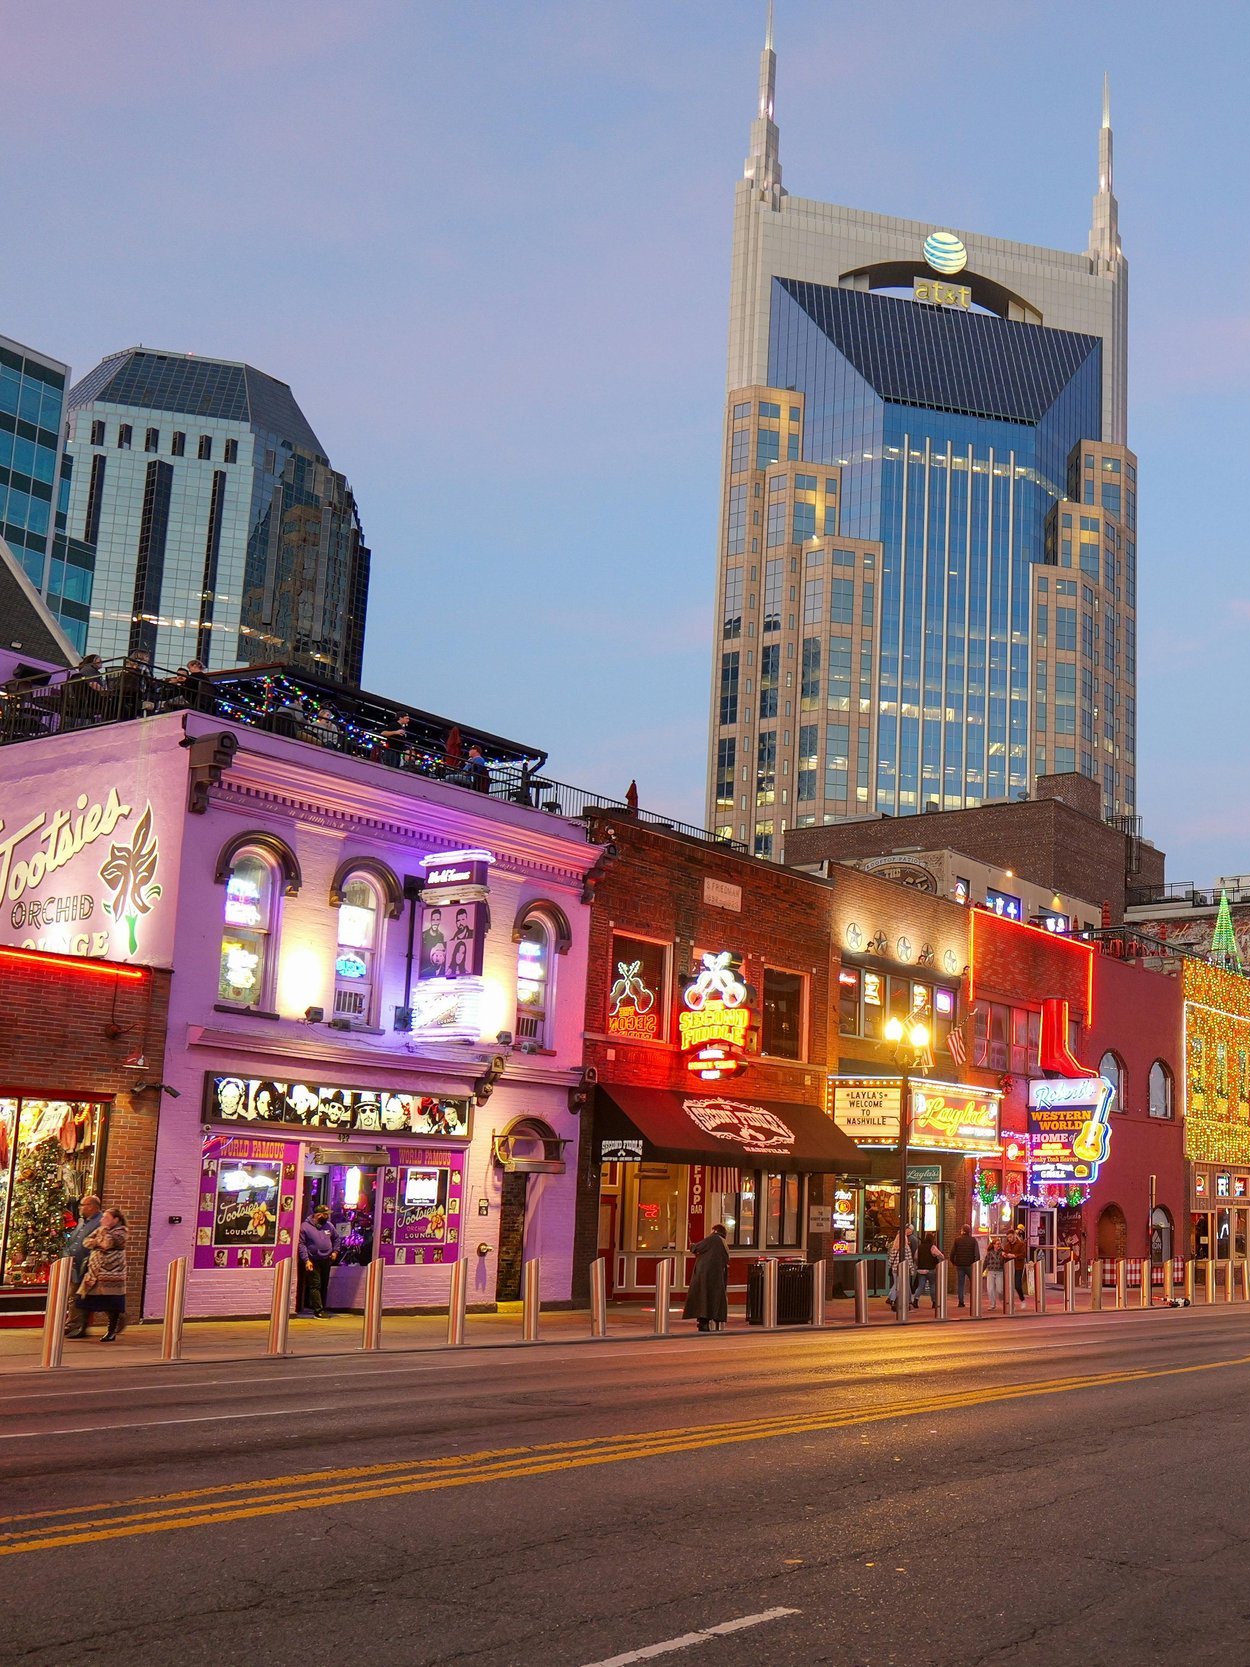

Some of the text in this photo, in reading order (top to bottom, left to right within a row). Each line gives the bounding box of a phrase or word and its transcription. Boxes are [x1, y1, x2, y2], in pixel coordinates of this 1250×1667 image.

[915, 282, 970, 309] at&t
[11, 895, 94, 930] ORCHID
[679, 1009, 749, 1031] SECOND
[681, 1026, 745, 1050] FIDDLE
[850, 1091, 884, 1100] LAYLA'S
[849, 1100, 883, 1108] WELCOME
[861, 1108, 871, 1116] TO
[918, 1097, 995, 1137] Layla's
[1031, 1110, 1092, 1121] WESTERN
[690, 1106, 791, 1138] SECOND FIDDLE
[846, 1116, 887, 1126] NASHVILLE
[1039, 1120, 1084, 1131] WORLD
[1032, 1133, 1069, 1143] HOME
[220, 1139, 285, 1159] WORLD FAMOUS
[601, 1139, 643, 1156] SECOND FIDDLE
[742, 1146, 791, 1155] NASHVILLE
[400, 1148, 452, 1166] WORLD FAMOUS
[217, 1202, 261, 1225] Tootsies
[690, 1204, 703, 1214] BAR
[397, 1205, 437, 1228] Tootsies
[225, 1228, 259, 1236] LOUNGE
[404, 1232, 437, 1240] LOUNGE
[833, 1243, 849, 1251] OPEN
